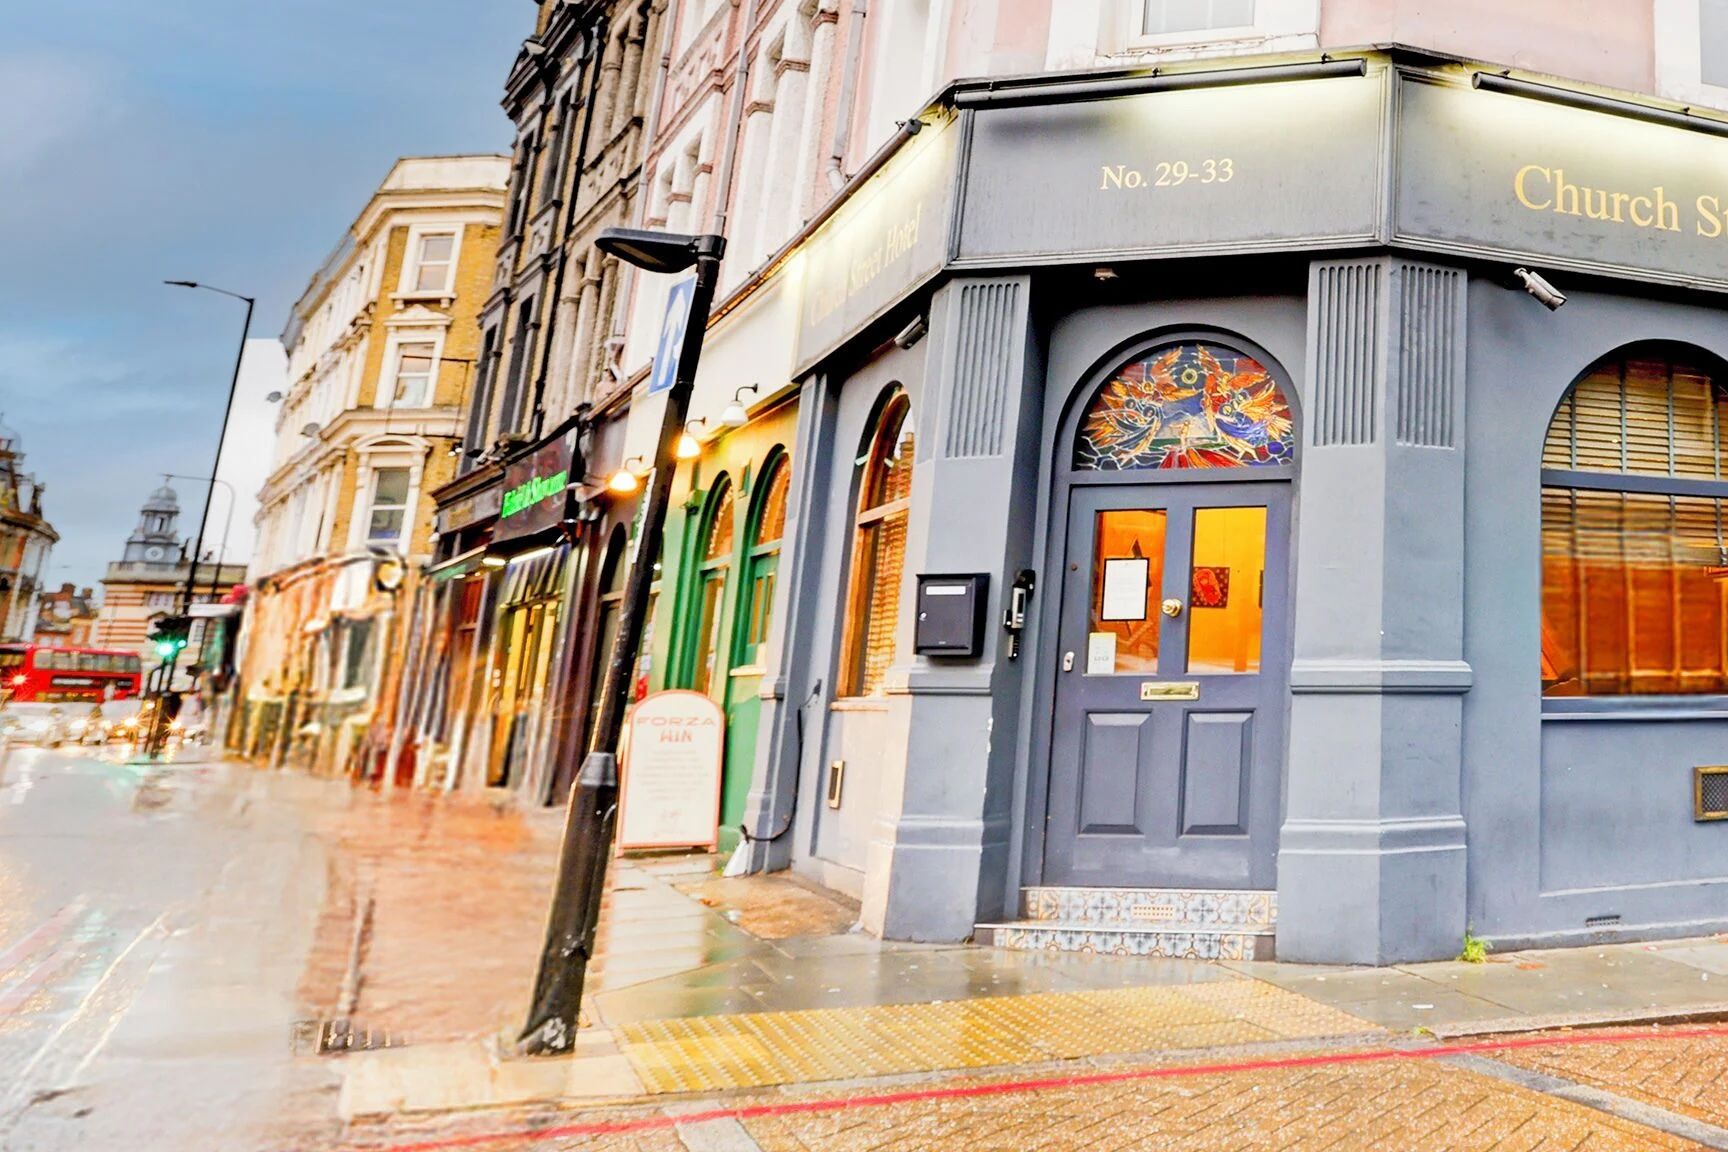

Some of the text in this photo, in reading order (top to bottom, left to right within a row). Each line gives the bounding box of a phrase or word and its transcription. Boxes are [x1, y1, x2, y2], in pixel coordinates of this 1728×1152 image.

[1099, 157, 1234, 190] No. 29-33
[1513, 163, 1681, 233] Church
[883, 201, 921, 267] Hotel
[636, 716, 716, 727] FORZA
